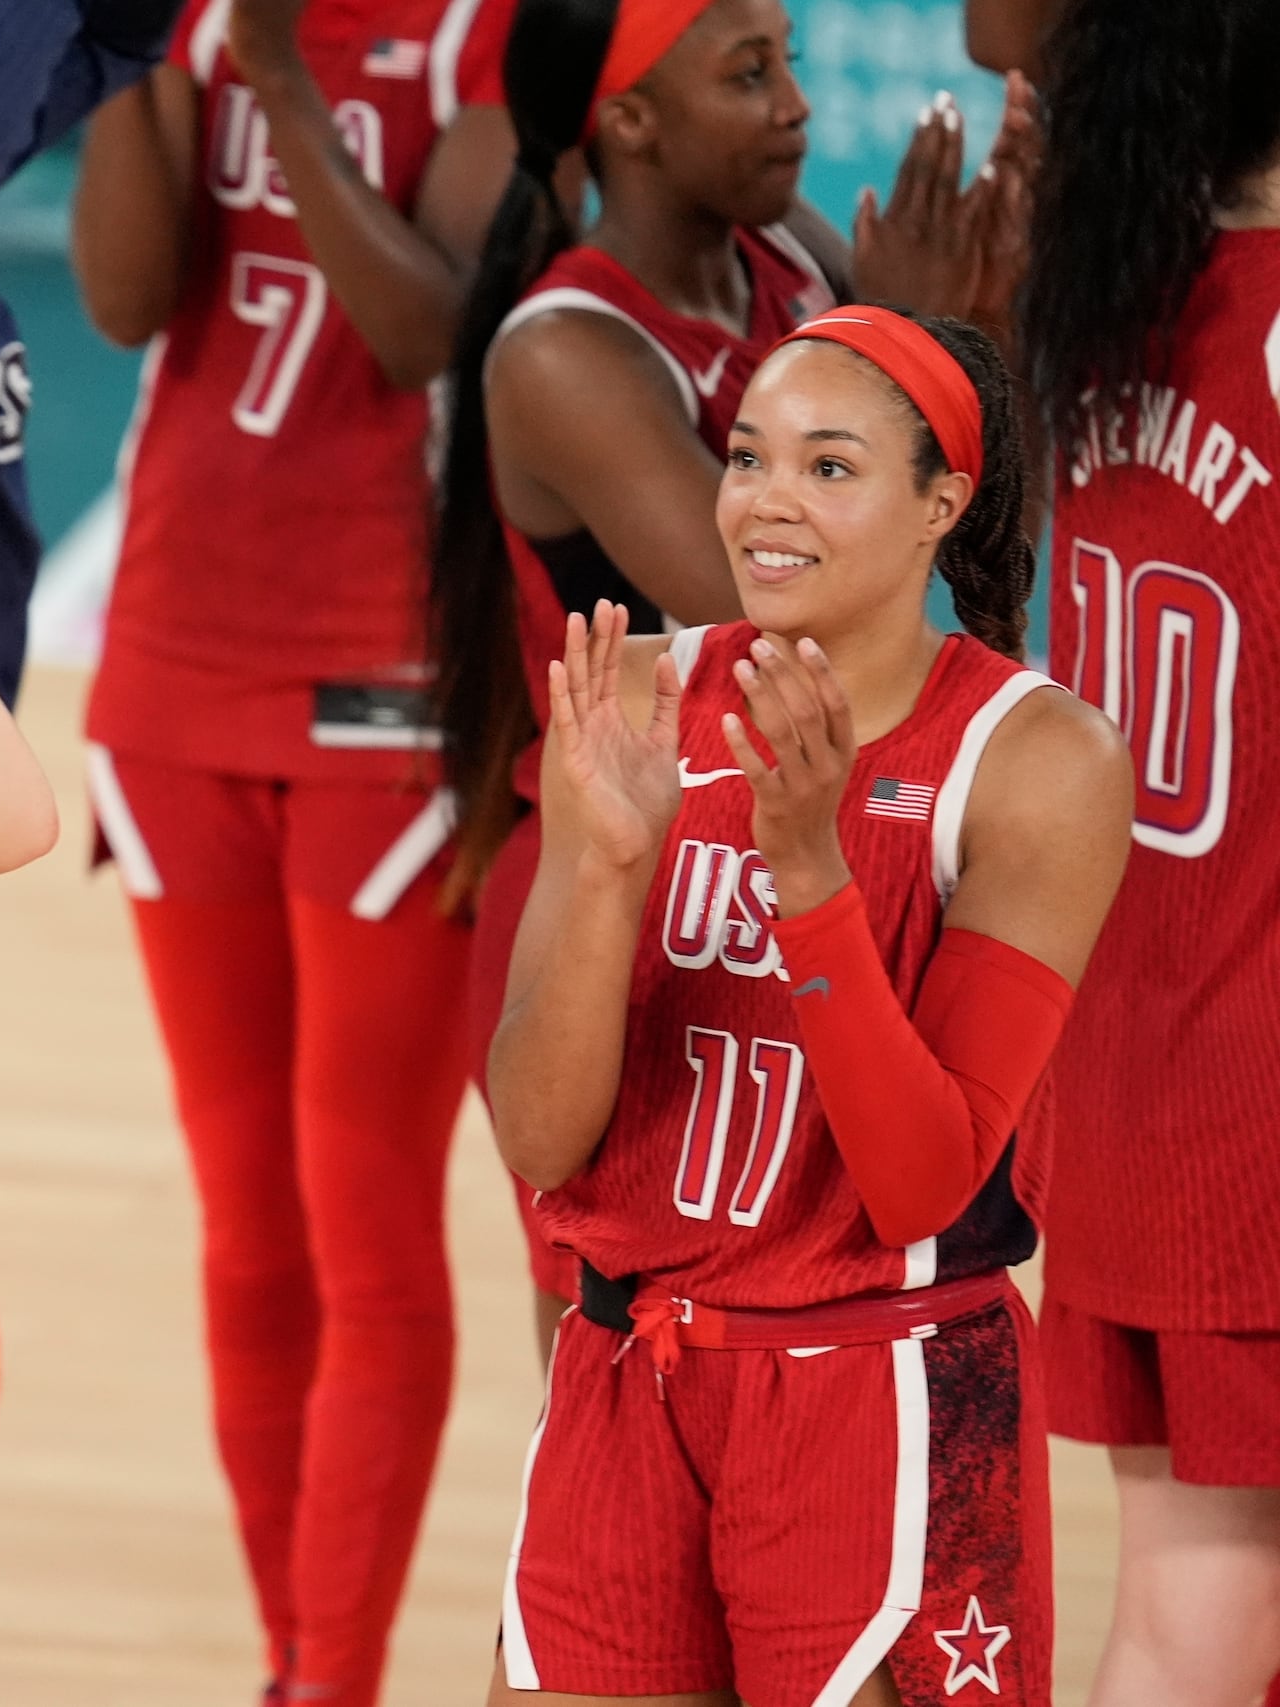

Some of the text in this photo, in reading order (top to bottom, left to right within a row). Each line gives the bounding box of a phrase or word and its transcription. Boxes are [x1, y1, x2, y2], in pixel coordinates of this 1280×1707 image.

[229, 252, 328, 437] 7
[1071, 536, 1240, 858] 10
[662, 839, 791, 982] US
[673, 1024, 805, 1228] 11
